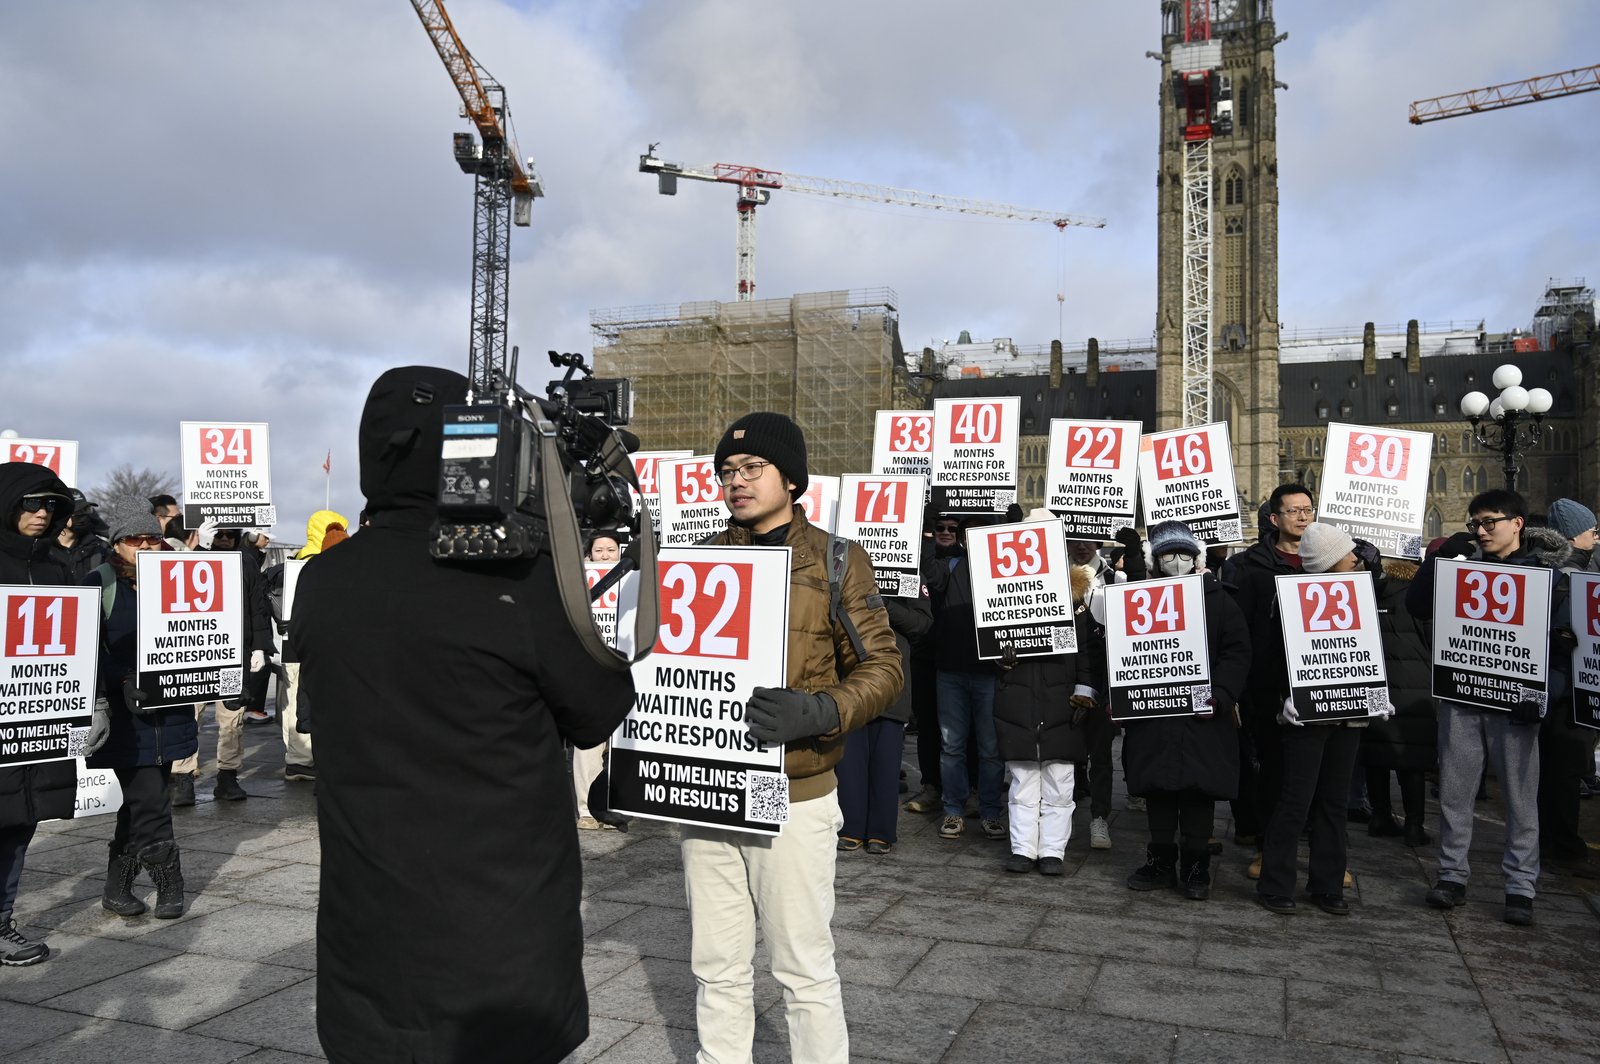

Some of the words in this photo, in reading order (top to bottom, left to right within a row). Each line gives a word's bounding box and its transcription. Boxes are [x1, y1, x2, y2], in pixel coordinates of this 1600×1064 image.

[955, 404, 997, 443] 40
[894, 416, 932, 451] 33
[205, 429, 248, 464] 34
[954, 449, 995, 457] MONTHS
[1071, 427, 1116, 468] 22
[892, 456, 929, 465] MONTHS
[1161, 434, 1206, 476] 46
[1352, 434, 1403, 478] 30
[883, 466, 918, 474] WAITING
[921, 467, 931, 475] FO
[944, 461, 983, 469] WAITING
[986, 460, 1005, 469] FOR
[206, 470, 248, 478] MONTHS
[638, 458, 659, 493] 4
[937, 473, 958, 481] IRCC
[959, 472, 1010, 481] RESPONSE
[1069, 473, 1113, 483] MONTHS
[196, 481, 237, 489] WAITING
[240, 480, 259, 489] FOR
[681, 462, 719, 503] 53
[1058, 484, 1100, 495] WAITING
[1103, 486, 1123, 496] FOR
[1165, 478, 1210, 493] MONTHS
[1349, 480, 1398, 495] MONTHS
[190, 491, 212, 500] IRCC
[214, 491, 265, 500] RESPONSE
[946, 489, 957, 497] NO
[958, 489, 995, 497] TIMELINE
[1155, 492, 1199, 507] WAITING
[1202, 489, 1223, 500] FOR
[1335, 491, 1384, 507] WAITING
[1387, 499, 1410, 510] FOR
[863, 482, 899, 522] 71
[949, 499, 960, 507] NO
[962, 499, 996, 507] RESULTS
[1051, 496, 1073, 506] IRCC
[1074, 497, 1129, 509] RESPONSE
[200, 507, 212, 515] NO
[681, 507, 720, 519] MONTHS
[1151, 508, 1174, 520] IRCC
[1175, 500, 1231, 516] RESPONSE
[1326, 503, 1352, 516] IRCC
[1353, 507, 1416, 524] RESPONSE
[672, 519, 710, 531] WAITING
[1060, 513, 1071, 522] NO
[1072, 514, 1112, 524] TIMELINE
[1187, 520, 1217, 531] ELINE
[858, 527, 898, 538] MONTHS
[1063, 524, 1074, 533] NO
[1076, 525, 1112, 535] RESULTS
[1336, 522, 1349, 532] NO
[667, 532, 687, 544] IRCC
[1193, 530, 1219, 540] SULTS
[1354, 536, 1396, 549] SULTS
[852, 539, 886, 549] ITING
[889, 541, 908, 550] FOR
[869, 552, 913, 563] ESPONSE
[996, 529, 1042, 577] 53
[875, 570, 902, 579] ELINES
[170, 561, 215, 612] 19
[876, 580, 898, 590] ULTS
[997, 580, 1044, 594] MONTHS
[987, 595, 1033, 609] WAITING
[1035, 592, 1058, 604] FOR
[1462, 570, 1517, 623] 39
[659, 563, 740, 656] 32
[982, 611, 1006, 622] IRCC
[1007, 605, 1066, 620] RESPONSE
[1130, 585, 1179, 634] 34
[1305, 582, 1354, 631] 23
[16, 596, 66, 655] 11
[167, 619, 217, 632] MONTHS
[155, 634, 204, 649] WAITING
[207, 633, 229, 646] FOR
[994, 629, 1007, 639] NO
[1462, 625, 1516, 642] MONTHS
[1000, 640, 1012, 650] NO
[1014, 638, 1053, 649] RESULTS
[1132, 638, 1180, 652] MONTHS
[1311, 636, 1357, 651] MONTHS
[1449, 637, 1501, 655] WAITING
[1505, 645, 1531, 659] FOR
[147, 652, 174, 665] IRCC
[176, 648, 236, 662] RESPONSE
[1121, 653, 1168, 667] WAITING
[1171, 651, 1194, 663] FOR
[1301, 652, 1347, 666] WAITING
[1349, 650, 1371, 662] FOR
[1440, 650, 1468, 664] IRCC
[1469, 654, 1538, 675] RESPONSE
[11, 663, 67, 678] MONTHS
[1115, 670, 1140, 681] IRCC
[1141, 664, 1201, 680] RESPONSE
[1297, 668, 1321, 681] IRCC
[1323, 664, 1379, 679] RESPONSE
[159, 674, 173, 685] NO
[656, 667, 736, 692] MONTHS
[1452, 672, 1467, 683] NO
[1469, 674, 1523, 692] TIMELINES
[1578, 671, 1599, 686] IRCC
[56, 680, 81, 694] FOR
[163, 687, 177, 698] NO
[179, 684, 220, 696] RESULTS
[1127, 689, 1141, 699] NO
[1142, 686, 1191, 698] TIMELINES
[1456, 684, 1471, 695] NO
[1473, 687, 1519, 704] RESULTS
[1310, 690, 1324, 700] NO
[1589, 696, 1600, 707] NO
[0, 702, 16, 715] CC
[18, 696, 87, 714] RESPONSE
[635, 692, 712, 720] WAITING
[719, 701, 749, 723] FO
[1132, 700, 1146, 710] NO
[1147, 698, 1188, 709] RESULTS
[1315, 702, 1329, 713] NO
[1330, 699, 1368, 711] RESULTS
[0, 728, 15, 740] NO
[17, 722, 73, 739] TIMELINES
[622, 718, 662, 743] IRCC
[666, 725, 769, 753] RESPONSE
[2, 742, 19, 755] NO
[21, 738, 68, 753] RESULTS
[78, 774, 111, 788] ence.
[638, 760, 660, 780] NO
[663, 762, 746, 790] TIMELINES
[74, 797, 106, 811] airs.
[644, 783, 666, 802] NO
[669, 787, 739, 813] RESULTS
